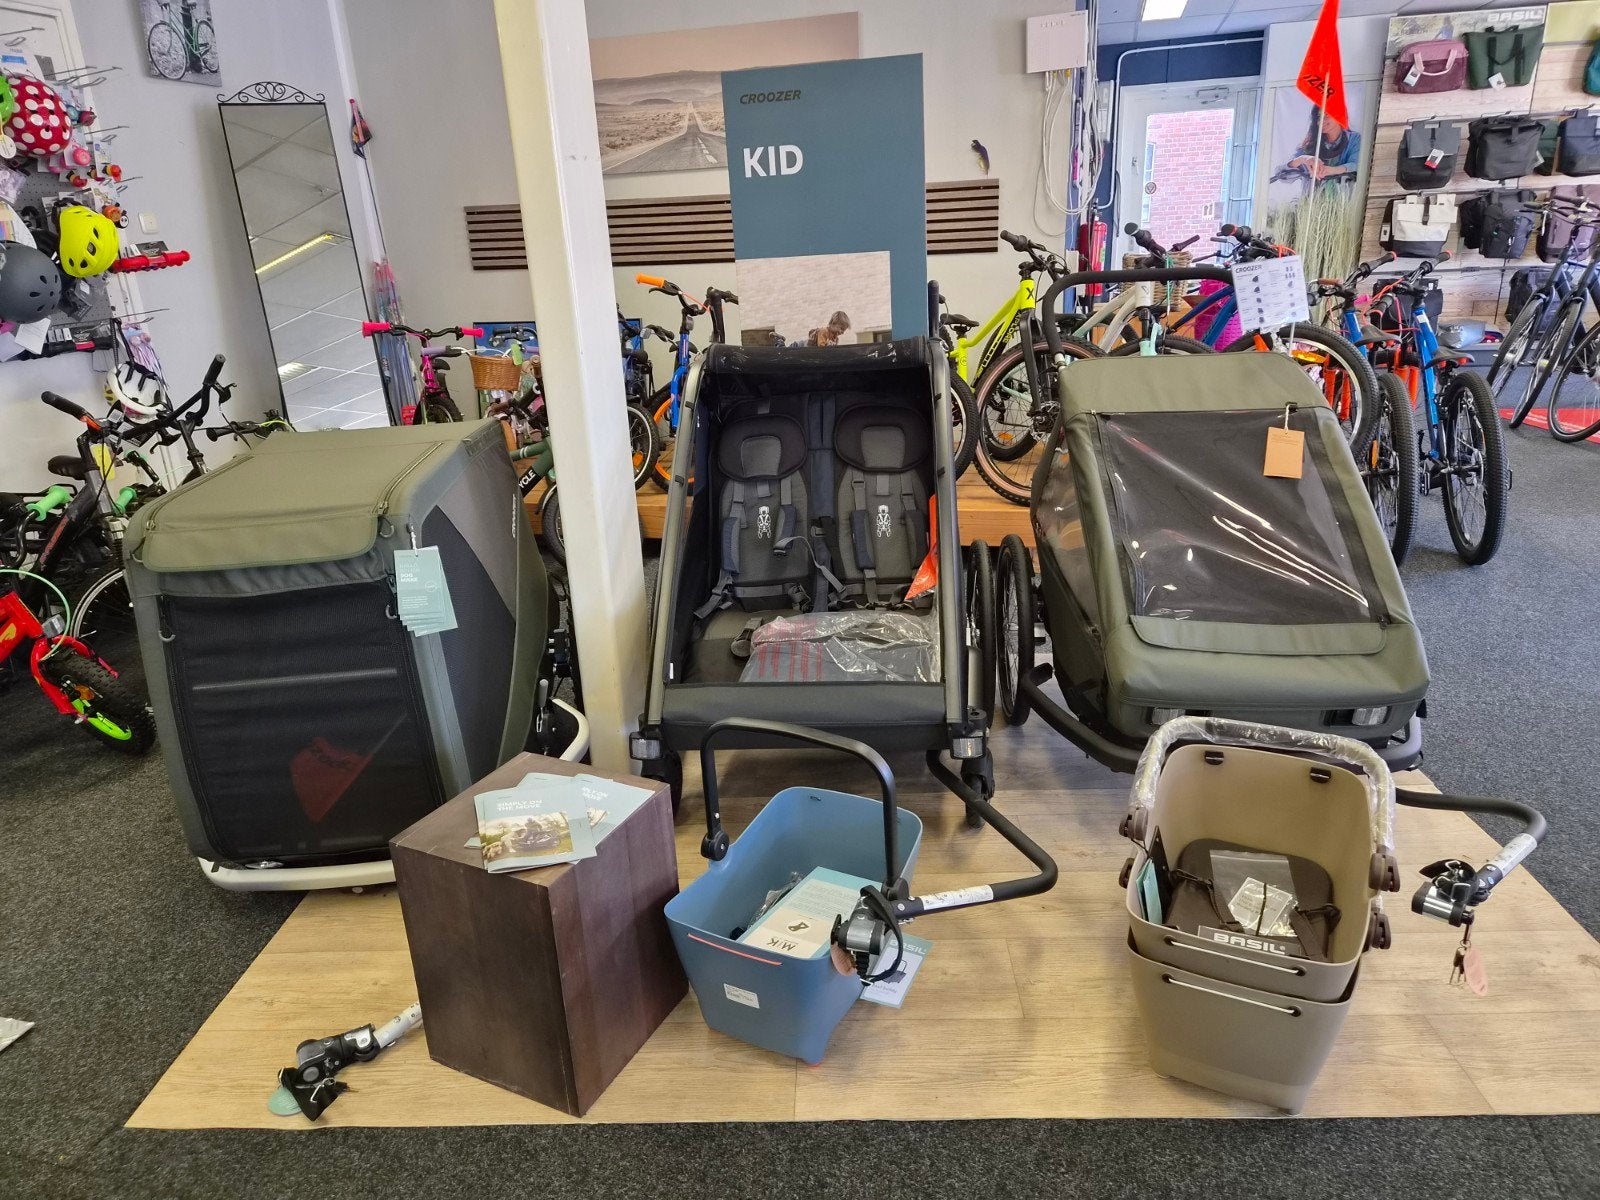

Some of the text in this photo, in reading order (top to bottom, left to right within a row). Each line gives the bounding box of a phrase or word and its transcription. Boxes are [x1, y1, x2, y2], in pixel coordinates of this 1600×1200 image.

[1487, 9, 1542, 22] BASIL
[739, 89, 802, 105] CROOZER
[743, 144, 803, 178] KID
[1235, 264, 1263, 274] CROOZER
[497, 799, 527, 808] SIMPLY
[1213, 932, 1286, 955] BASIL
